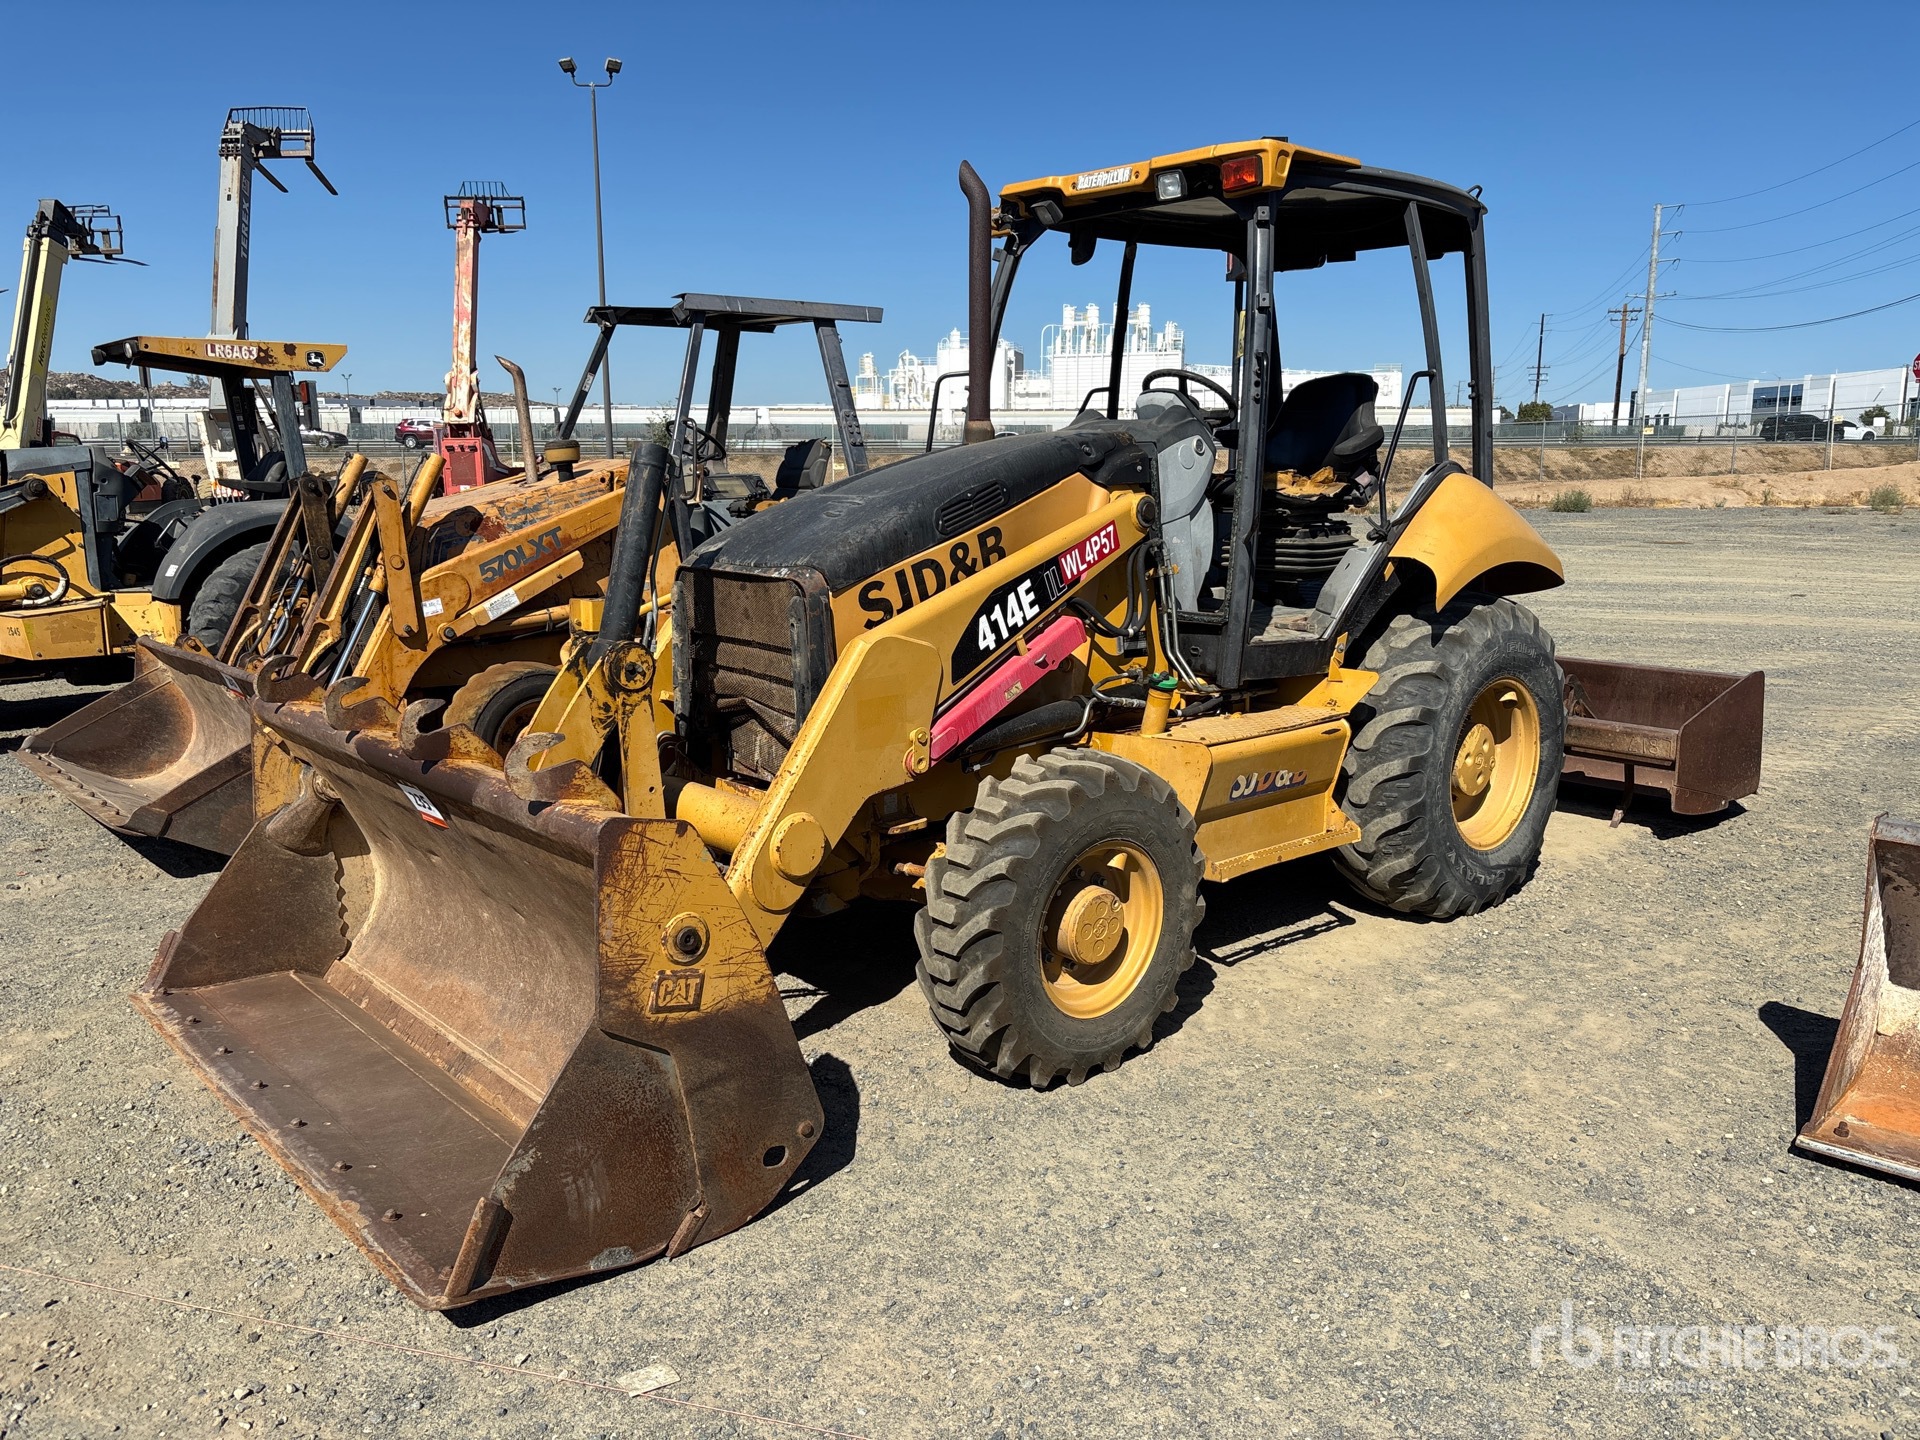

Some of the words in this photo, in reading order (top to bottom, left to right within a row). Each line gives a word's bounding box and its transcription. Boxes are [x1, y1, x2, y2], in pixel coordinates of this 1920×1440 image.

[240, 199, 250, 259] TEREX
[38, 306, 52, 367] HercRentals
[207, 344, 258, 360] LR6A63
[478, 525, 562, 583] 570LXT
[857, 526, 1007, 630] SJD&B
[1061, 524, 1116, 581] WL4P57
[977, 578, 1040, 651] 414E
[1444, 848, 1507, 887] GALAXY
[657, 978, 700, 1007] CAT
